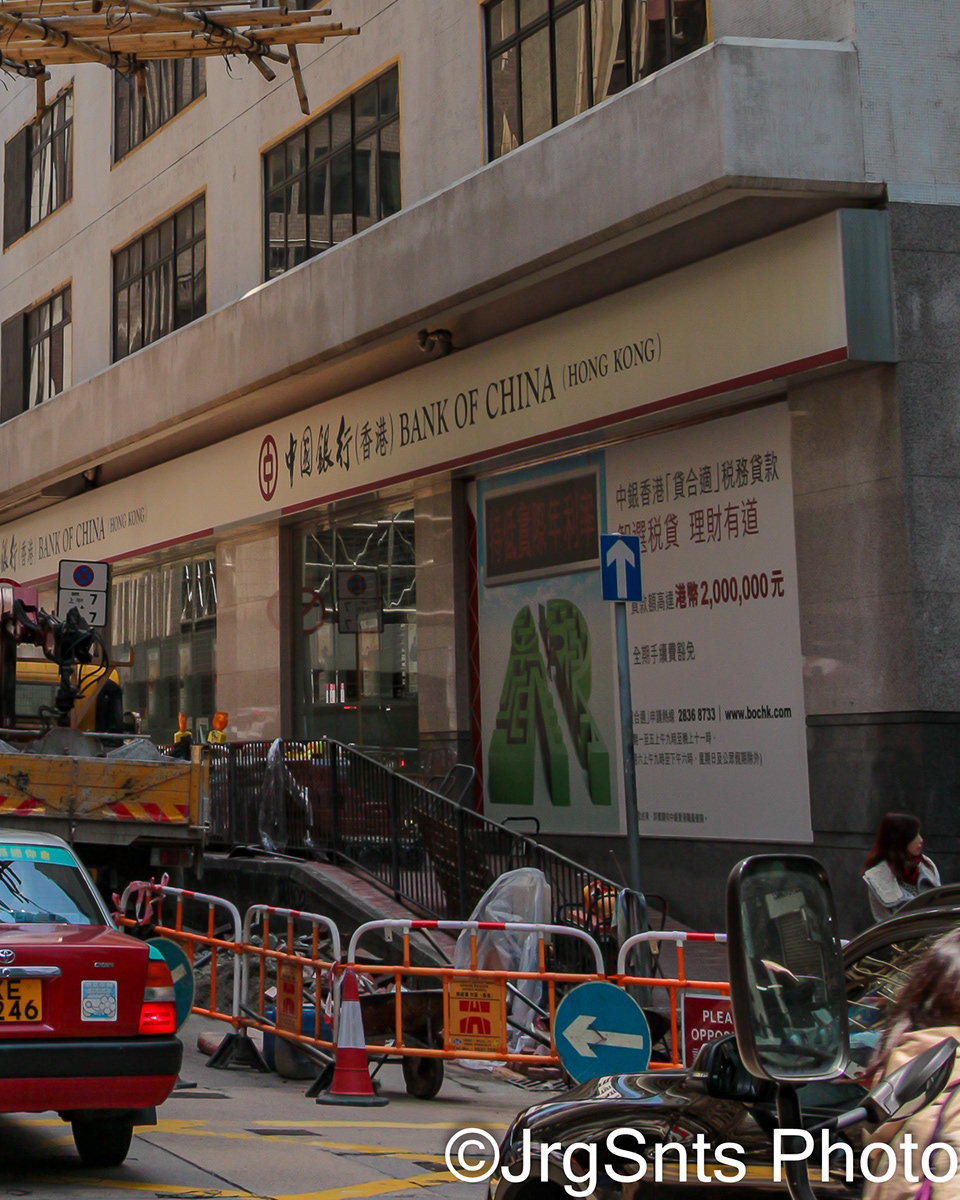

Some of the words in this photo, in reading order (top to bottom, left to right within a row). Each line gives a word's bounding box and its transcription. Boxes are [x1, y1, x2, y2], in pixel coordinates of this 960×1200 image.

[399, 398, 449, 448] BANK
[454, 388, 479, 429] OF
[485, 364, 556, 419] CHINA
[38, 531, 61, 560] BANK
[62, 526, 74, 552] OF
[75, 516, 106, 548] CHINA
[688, 498, 759, 544] 理財有道
[90, 594, 97, 605] 7
[700, 572, 768, 610] 2,000,000
[771, 569, 784, 598] 元
[89, 612, 97, 623] 7
[678, 709, 696, 722] 2836
[697, 708, 716, 722] 8733
[725, 705, 792, 721] www.bochk.com
